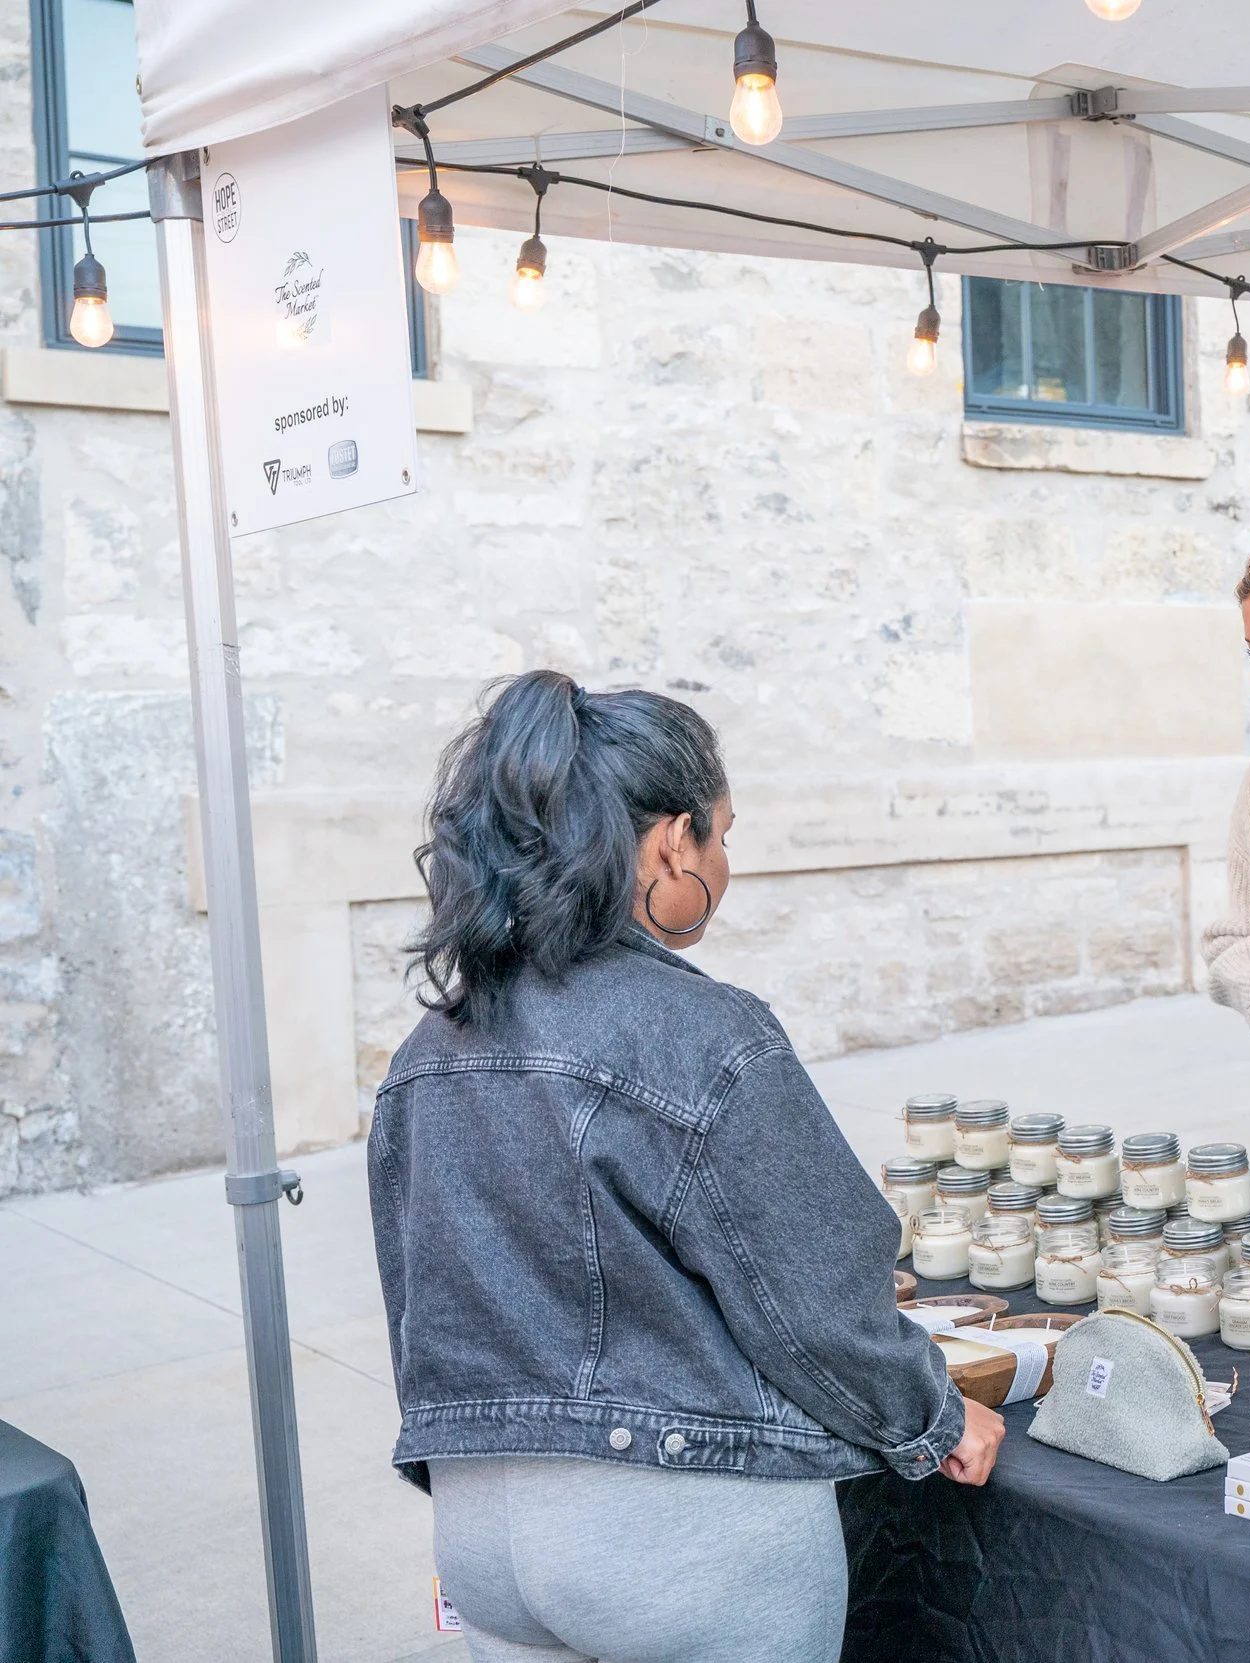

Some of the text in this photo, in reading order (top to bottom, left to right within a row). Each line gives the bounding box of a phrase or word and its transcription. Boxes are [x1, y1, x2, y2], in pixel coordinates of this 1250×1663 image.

[214, 181, 237, 214] HOPE
[217, 211, 237, 234] STREET
[275, 268, 324, 304] The Scented
[274, 395, 350, 435] sponsored by:
[282, 464, 312, 482] TRIUMPH
